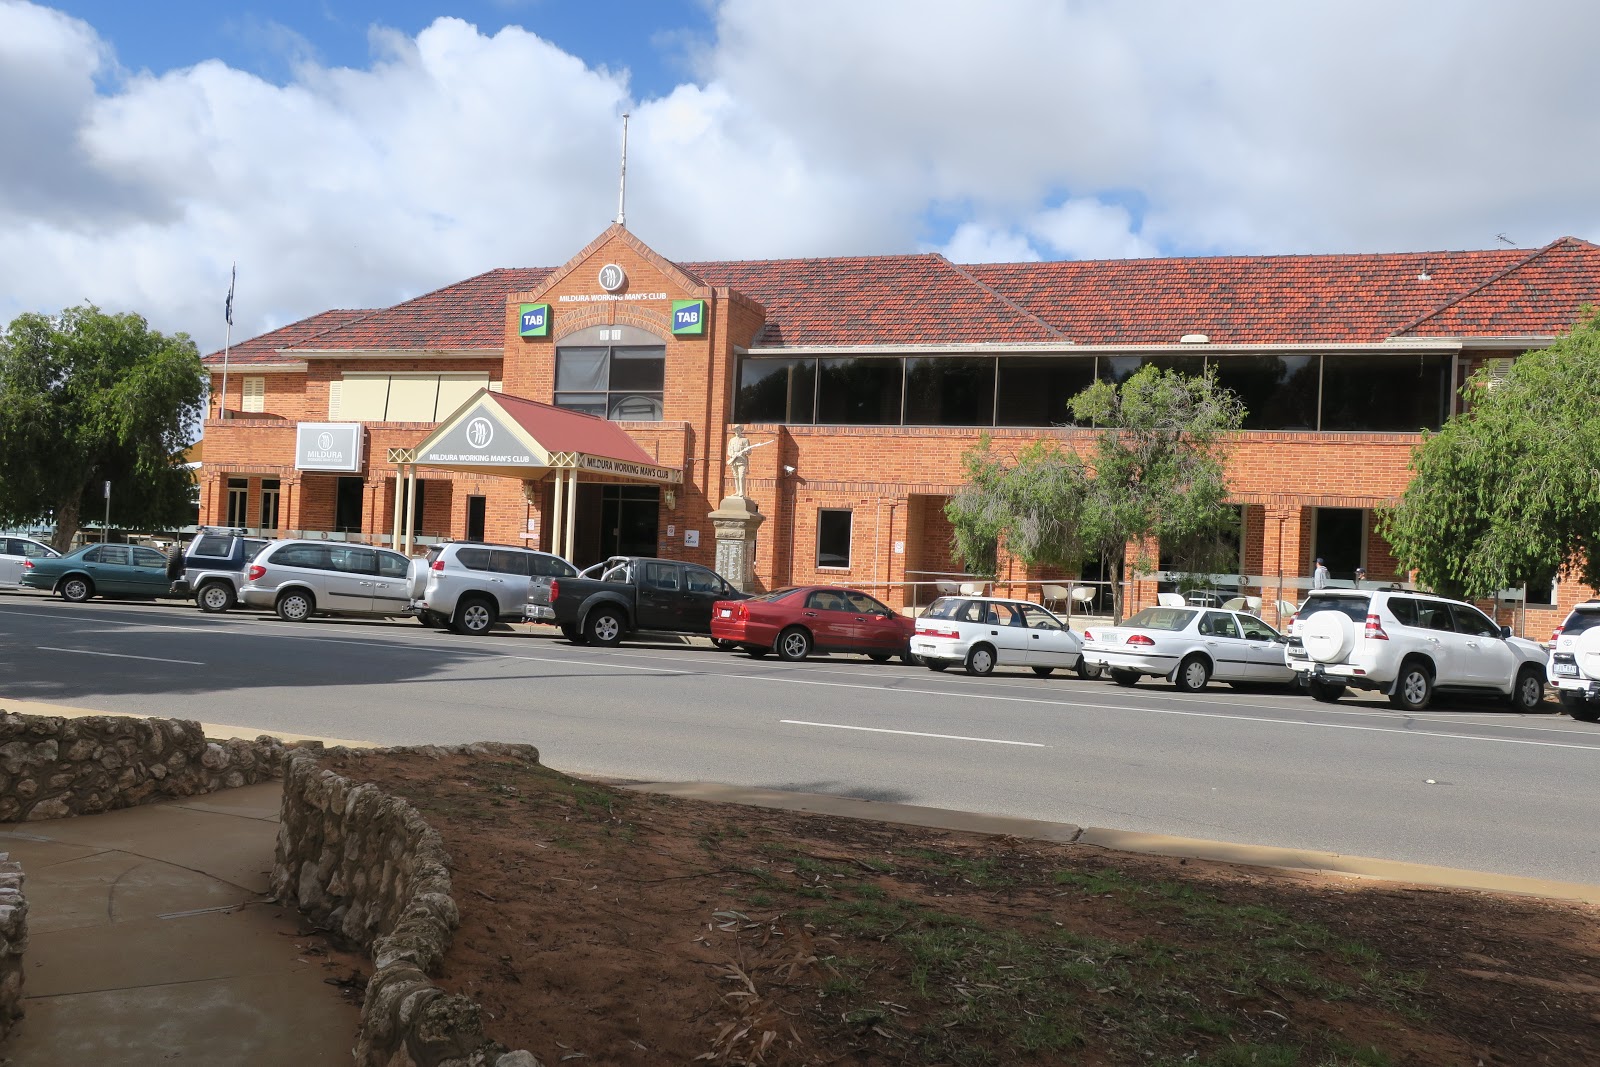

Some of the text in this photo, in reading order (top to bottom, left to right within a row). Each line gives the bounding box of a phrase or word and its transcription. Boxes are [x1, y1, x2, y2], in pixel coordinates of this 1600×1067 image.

[591, 294, 623, 302] WORKING
[648, 292, 667, 300] CLUB
[524, 315, 543, 326] TAB
[677, 312, 698, 323] TAB
[307, 451, 343, 459] MILDURA
[459, 454, 490, 462] WORKING
[614, 462, 639, 475] WORKING
[639, 466, 656, 477] MAN'S
[656, 469, 669, 479] CLUB
